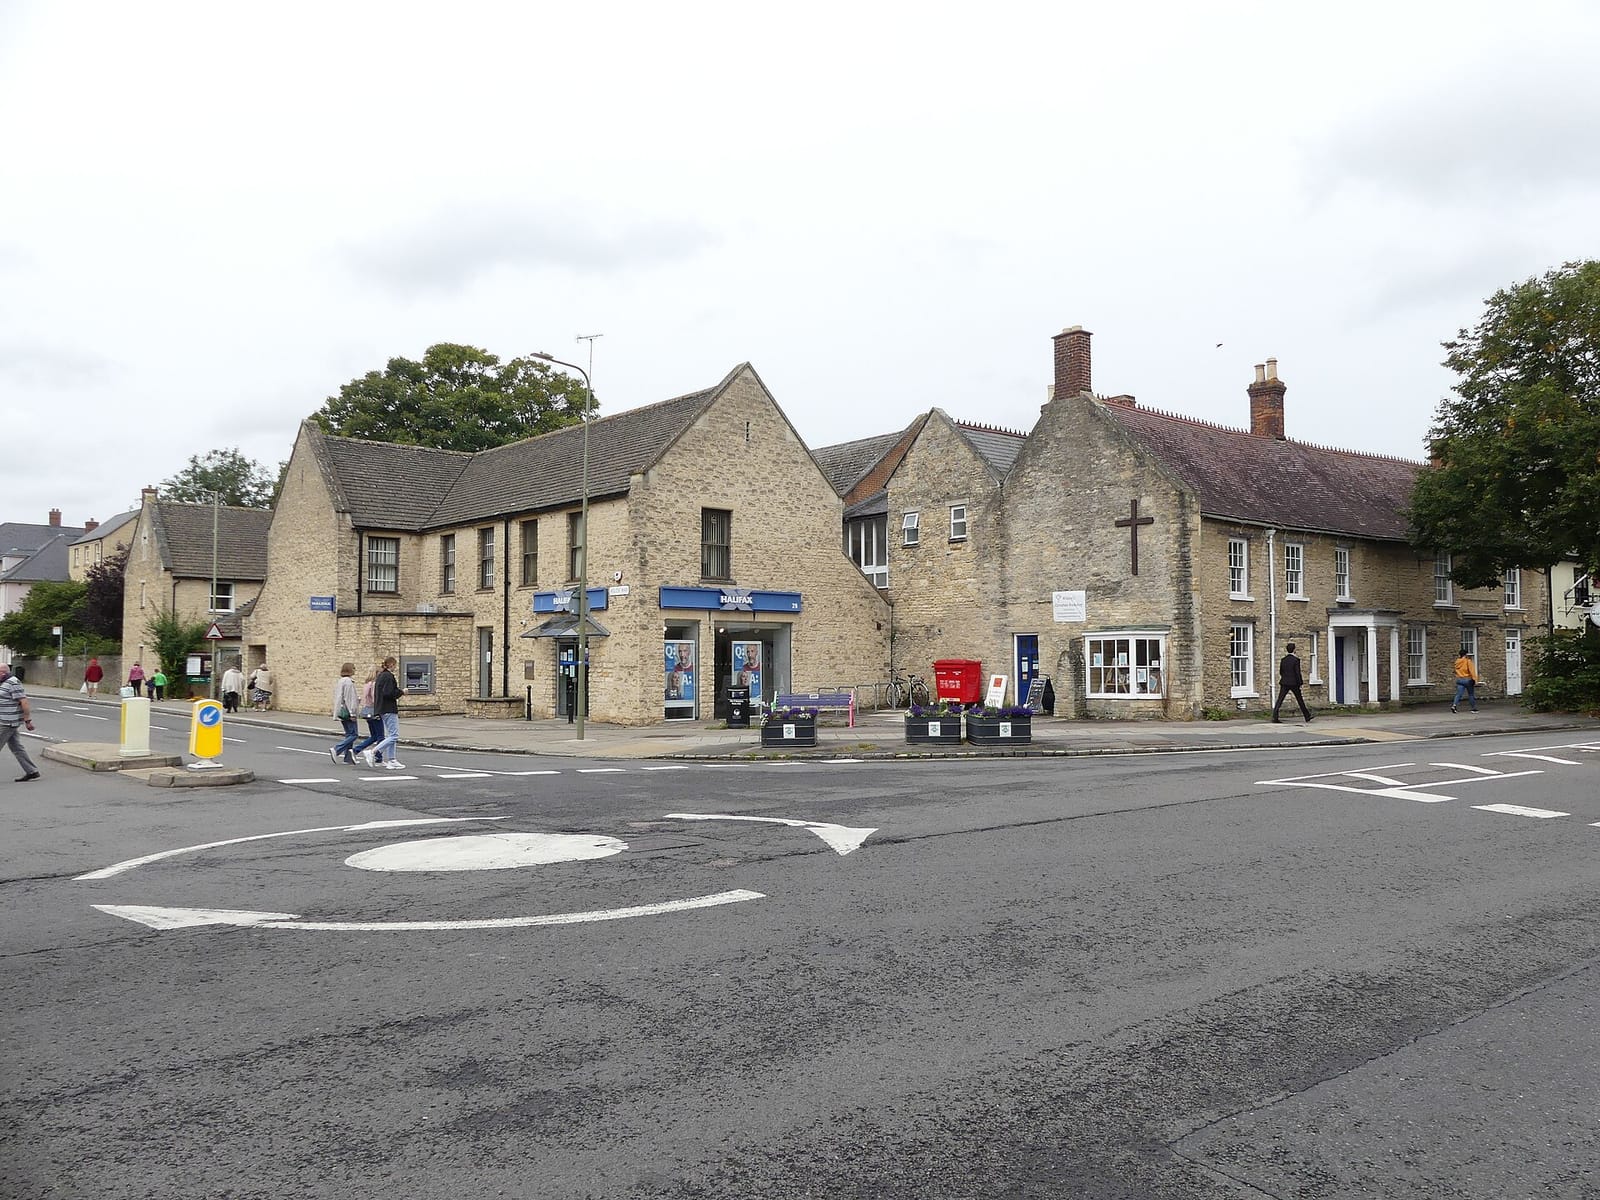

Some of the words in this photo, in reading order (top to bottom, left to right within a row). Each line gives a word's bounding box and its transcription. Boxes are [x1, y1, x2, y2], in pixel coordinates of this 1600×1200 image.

[720, 596, 753, 604] HALIFAX
[665, 645, 676, 659] Q:
[735, 646, 745, 659] Q:
[682, 674, 692, 685] A:
